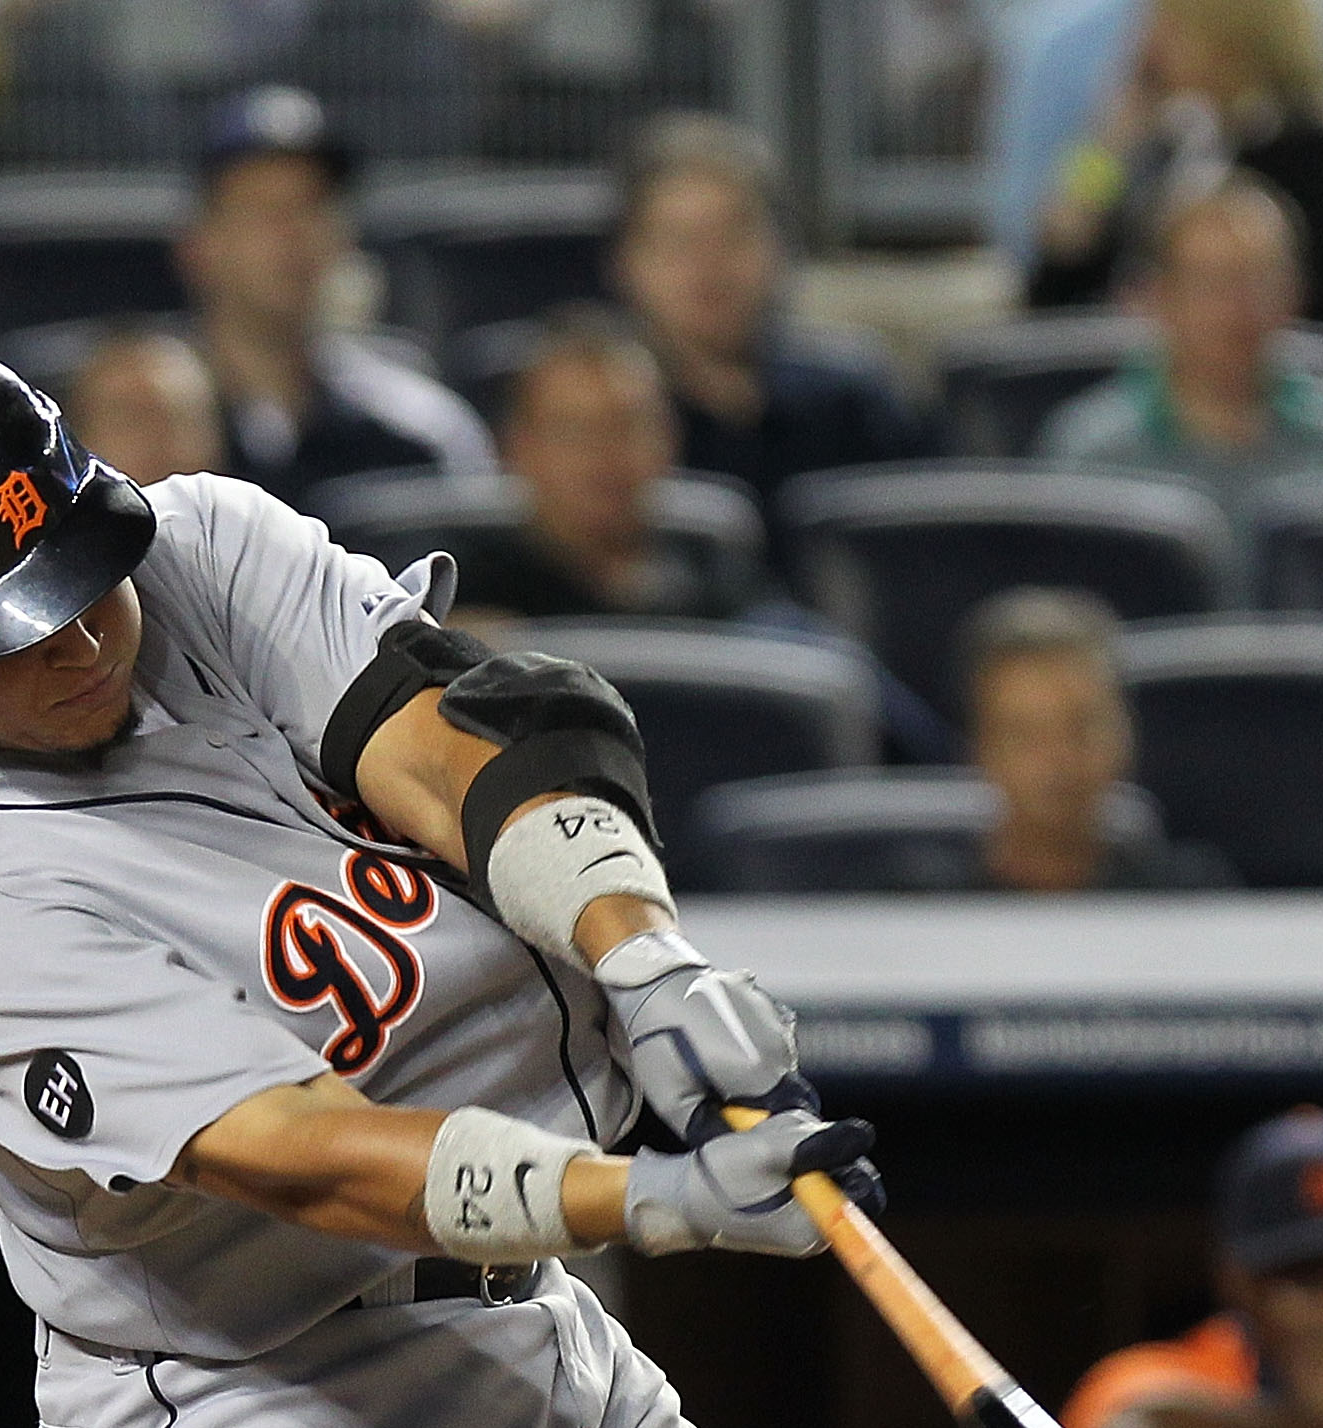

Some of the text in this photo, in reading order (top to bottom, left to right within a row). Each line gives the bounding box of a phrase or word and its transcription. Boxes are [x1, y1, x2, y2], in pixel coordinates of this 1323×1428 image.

[553, 807, 621, 840] 24
[260, 849, 439, 1077] De
[37, 1062, 79, 1129] EH
[455, 1163, 494, 1230] 24
